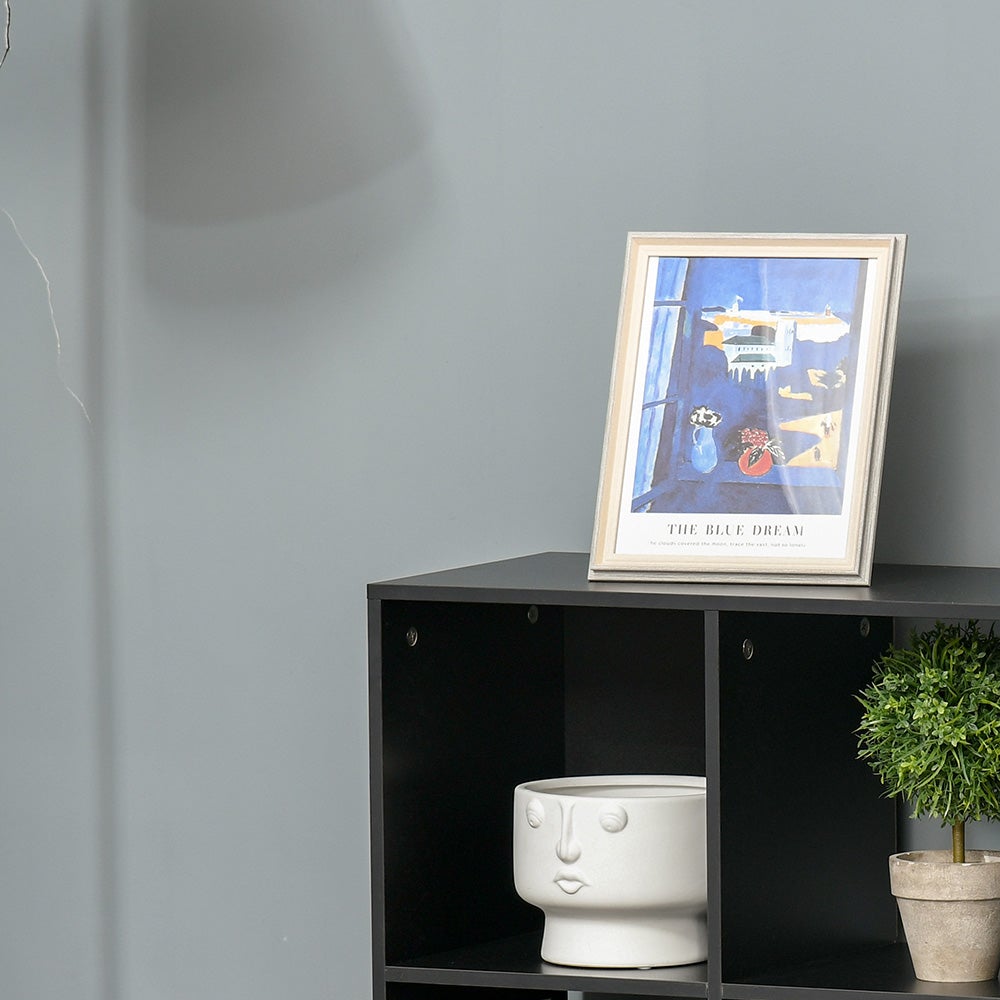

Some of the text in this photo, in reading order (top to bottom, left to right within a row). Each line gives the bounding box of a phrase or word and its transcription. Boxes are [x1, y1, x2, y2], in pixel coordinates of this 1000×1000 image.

[667, 523, 806, 537] THE BLUE DREAM
